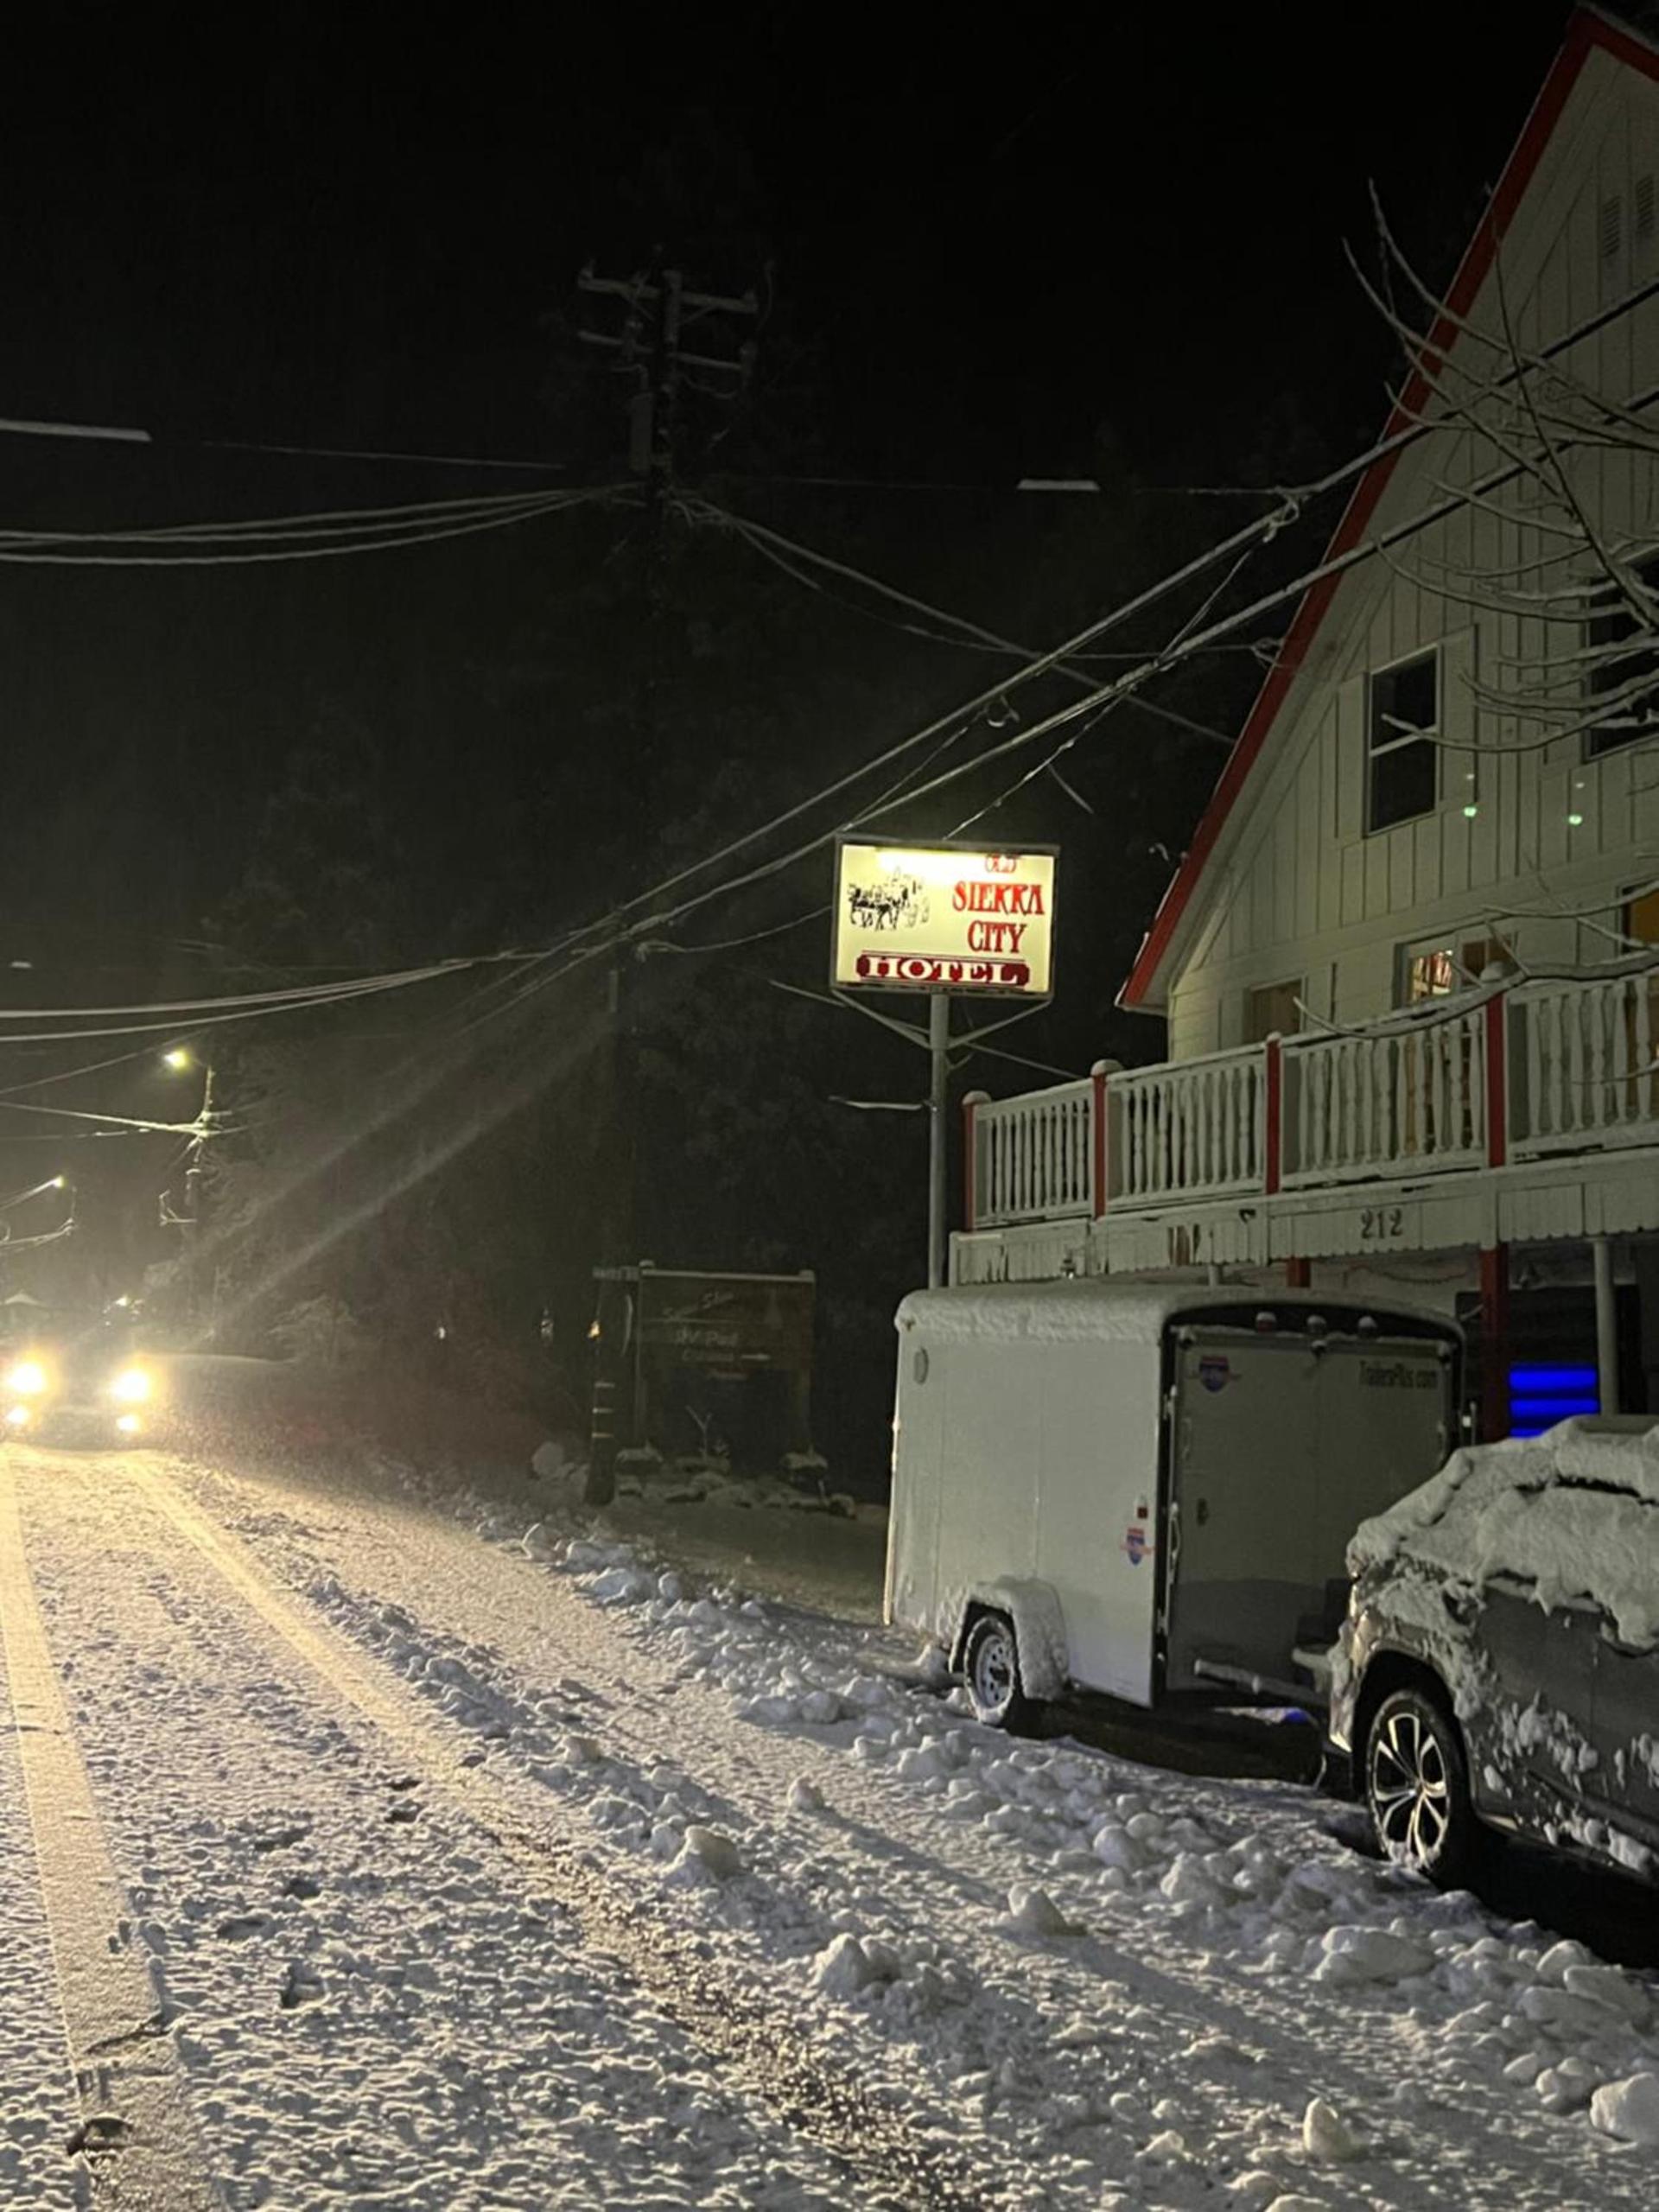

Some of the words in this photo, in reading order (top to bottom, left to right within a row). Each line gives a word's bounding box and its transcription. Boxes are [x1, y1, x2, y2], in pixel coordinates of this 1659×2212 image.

[952, 880, 1046, 916] SIERRA
[968, 920, 1027, 953] CITY
[868, 957, 1018, 983] HOTEL
[1361, 1206, 1403, 1239] 212
